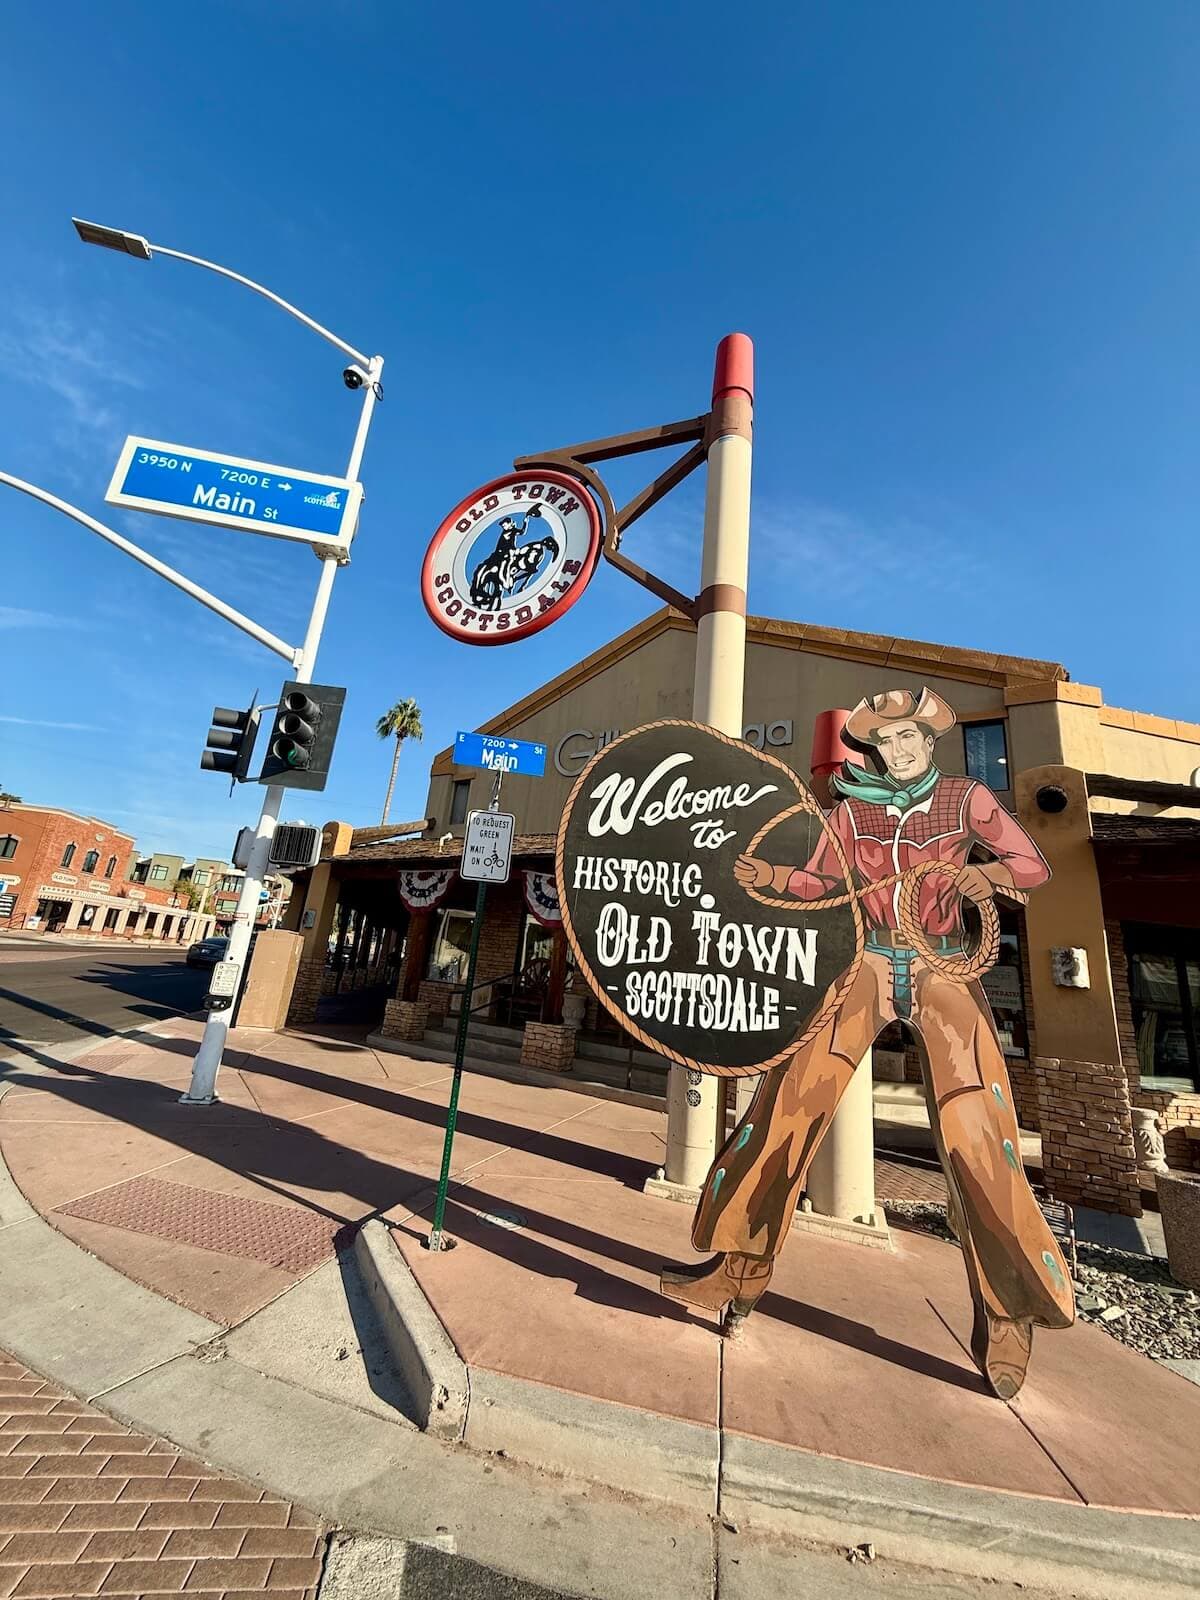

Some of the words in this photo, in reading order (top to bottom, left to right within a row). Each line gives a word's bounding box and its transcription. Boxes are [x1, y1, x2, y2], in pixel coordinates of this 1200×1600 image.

[138, 453, 178, 470] 3950
[180, 461, 193, 473] N
[220, 469, 258, 486] 7200
[261, 477, 271, 489] E
[192, 484, 256, 515] Main
[263, 507, 279, 520] St
[455, 495, 500, 534] OLD
[511, 484, 580, 516] TOWN
[434, 559, 582, 631] SCOTTSDALE
[458, 733, 465, 742] E
[482, 737, 506, 749] 7200
[481, 748, 518, 769] Main
[587, 752, 779, 837] Welcome
[472, 817, 480, 826] TO
[482, 818, 509, 830] REQUEST
[479, 829, 500, 839] GREEN
[689, 819, 737, 849] to
[469, 845, 485, 854] WAIT
[471, 856, 480, 865] ON
[573, 855, 703, 908] HISTORIC
[595, 902, 674, 967] OLD
[691, 909, 818, 986] TOWN
[625, 970, 780, 1032] SCOTTSDALE
